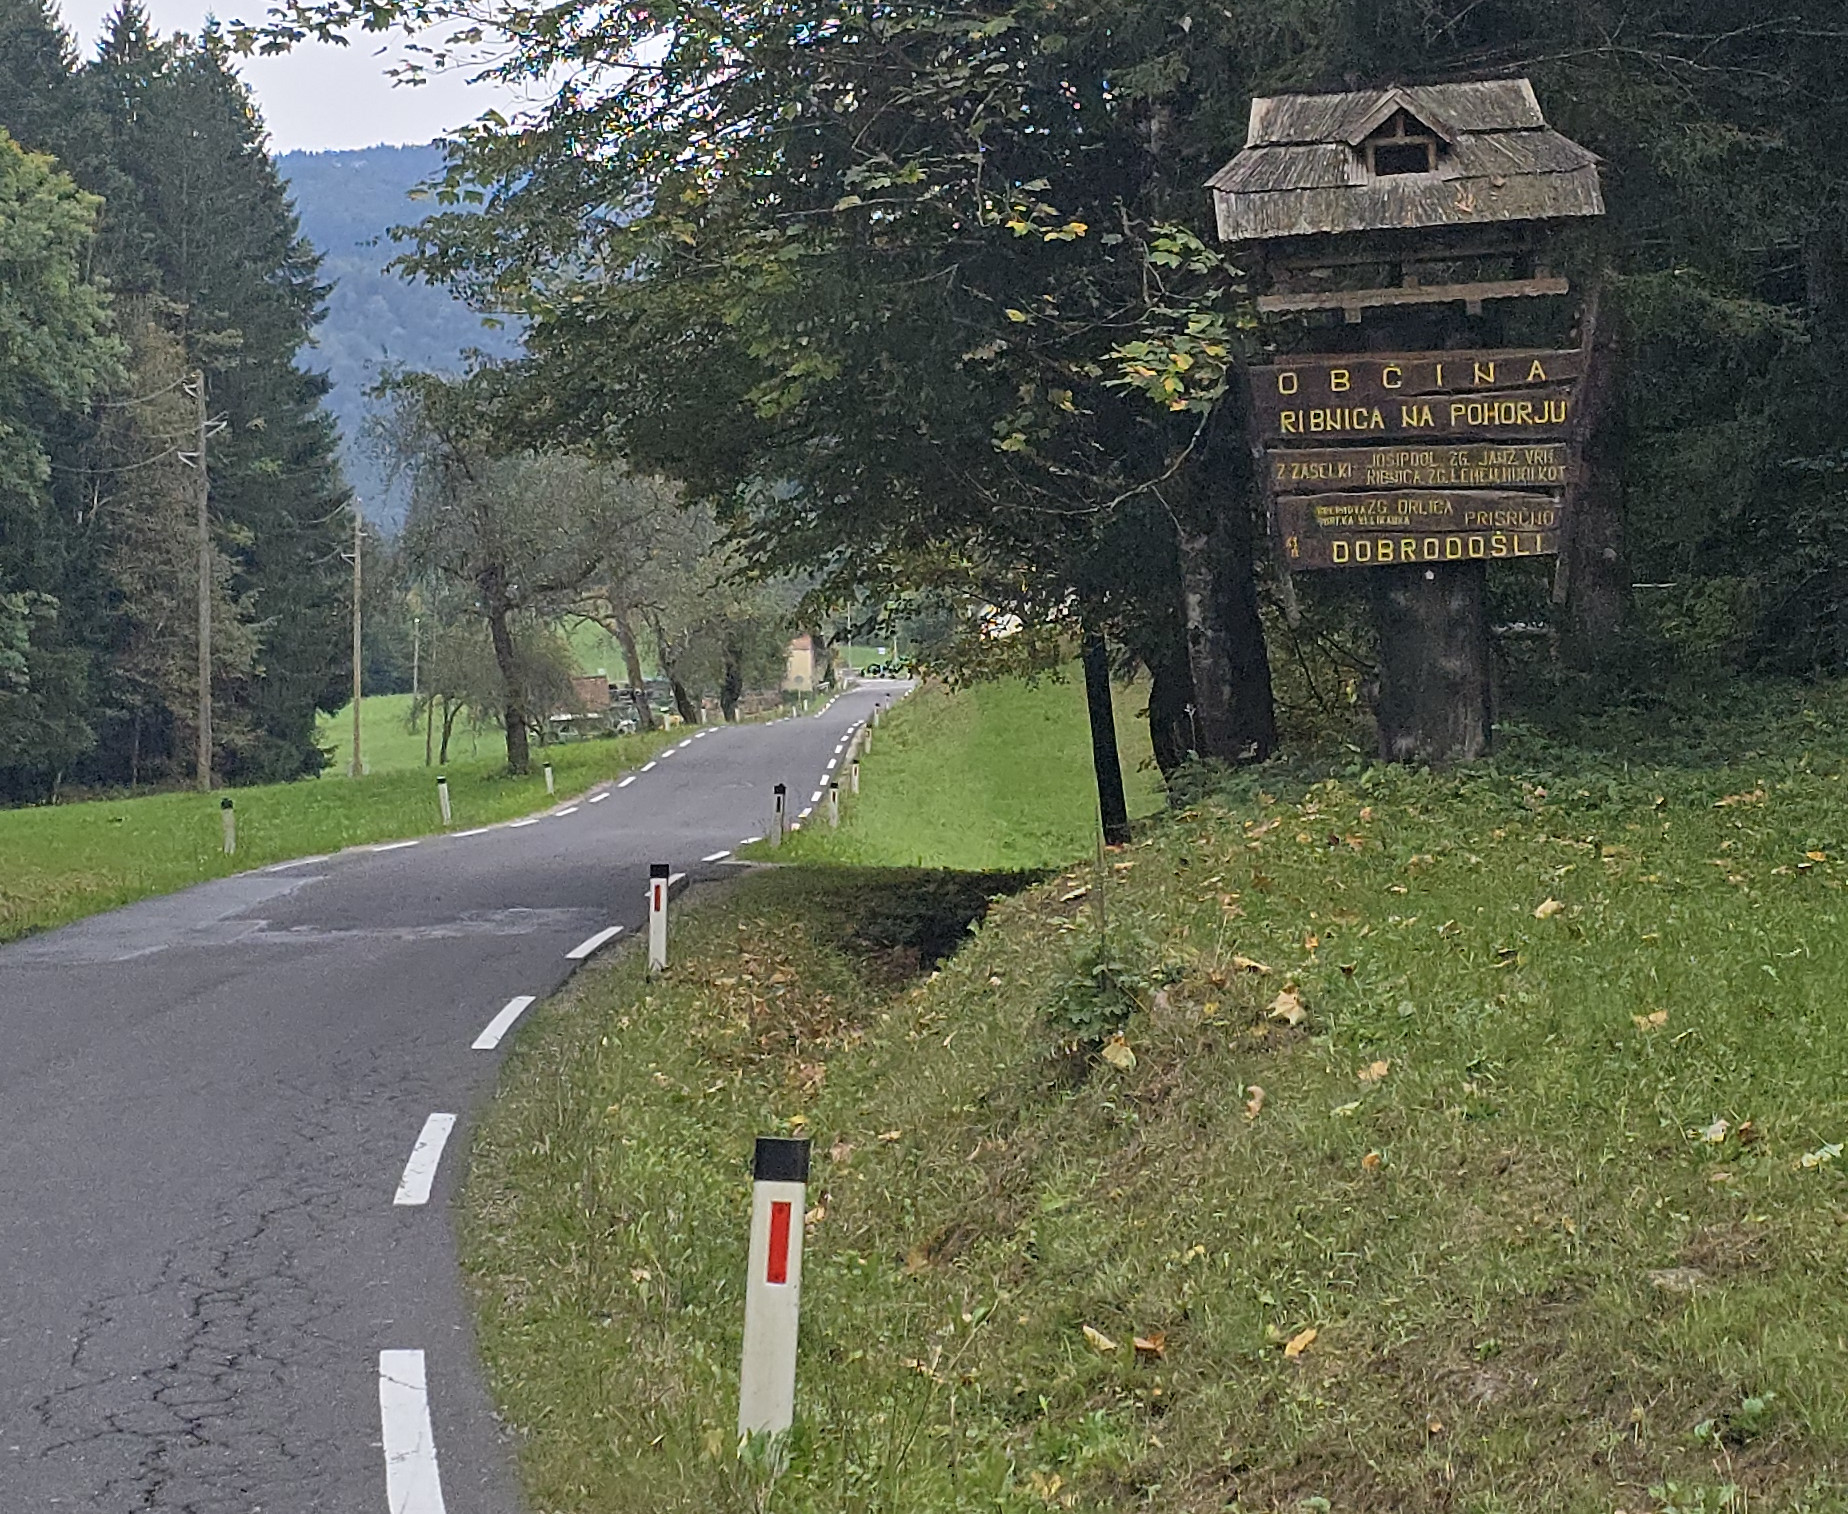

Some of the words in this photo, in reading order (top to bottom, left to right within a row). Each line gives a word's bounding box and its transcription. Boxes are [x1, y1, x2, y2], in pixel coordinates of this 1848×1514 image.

[1280, 406, 1385, 433] RIBNICA
[1401, 405, 1435, 427] NA
[1451, 401, 1566, 425] POHORJU
[1291, 462, 1352, 479] ZASELKI
[1539, 466, 1566, 481] KOT
[1398, 499, 1454, 515] ORLICA
[1332, 531, 1542, 563] DOBRODOŠLI
